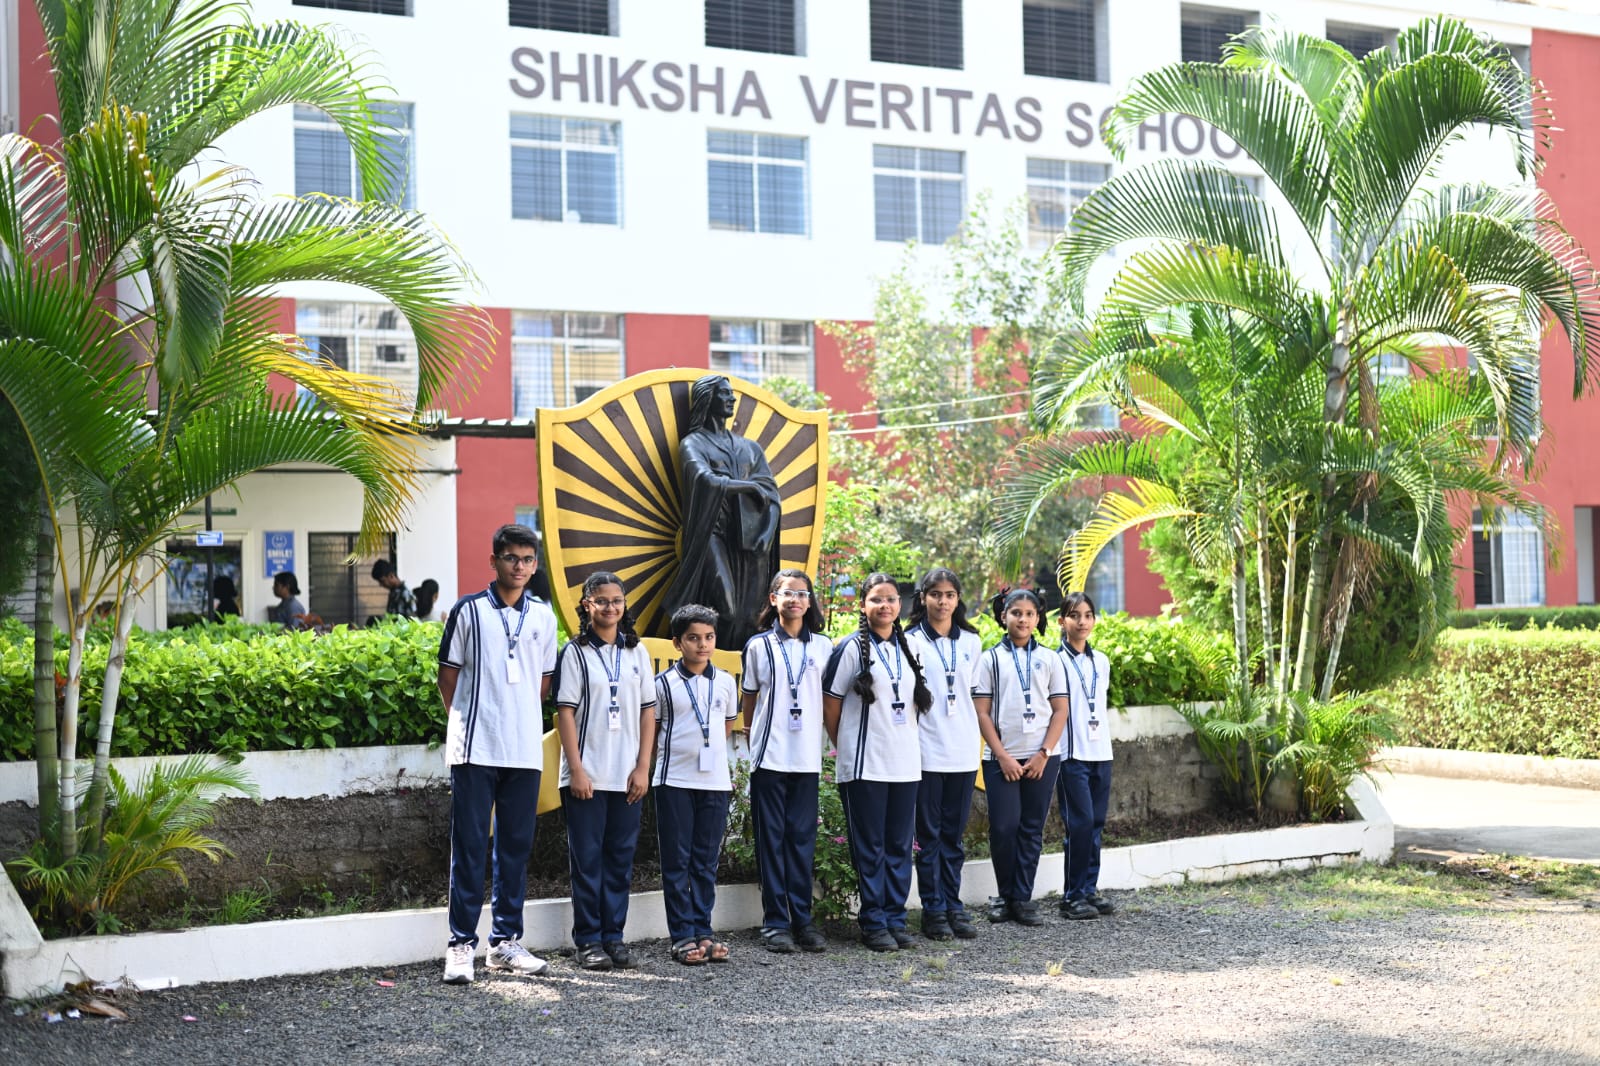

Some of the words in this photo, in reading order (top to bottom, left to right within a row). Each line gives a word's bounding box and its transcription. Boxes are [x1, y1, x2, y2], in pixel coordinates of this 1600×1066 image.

[509, 47, 772, 120] SHIKSHA
[800, 75, 1042, 142] VERITAS
[1066, 101, 1252, 160] SHOO
